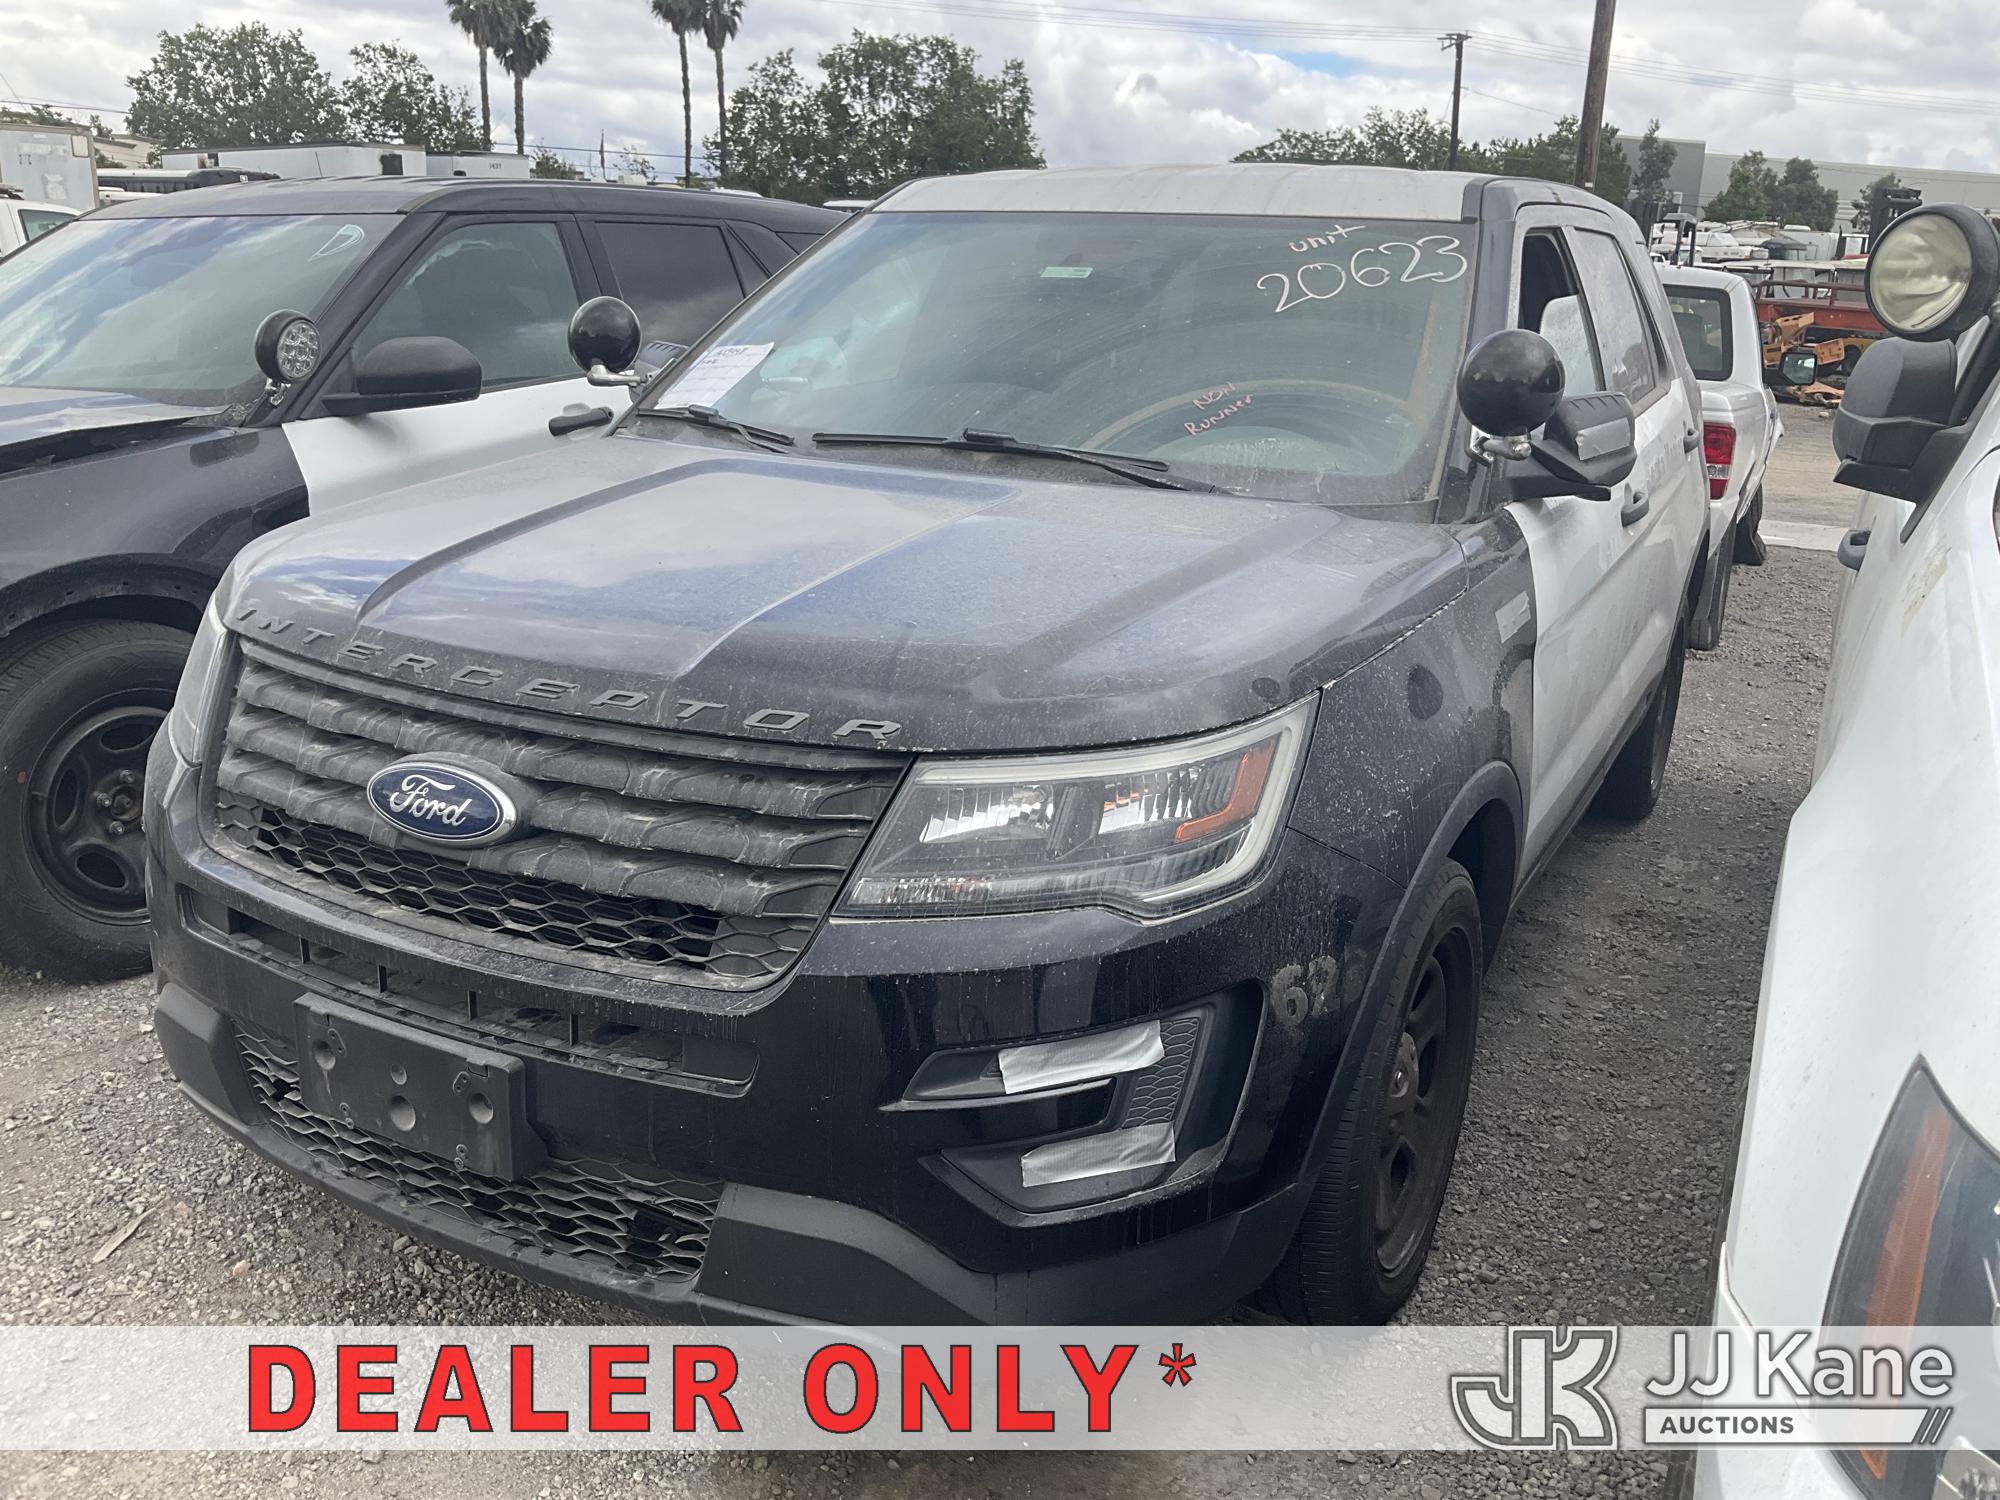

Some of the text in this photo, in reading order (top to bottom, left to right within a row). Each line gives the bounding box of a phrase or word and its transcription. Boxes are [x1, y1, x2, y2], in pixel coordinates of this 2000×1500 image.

[1256, 235, 1468, 313] 20623
[1192, 381, 1237, 410] NON
[235, 608, 904, 744] INTERCEPTOR
[389, 774, 473, 829] Ford
